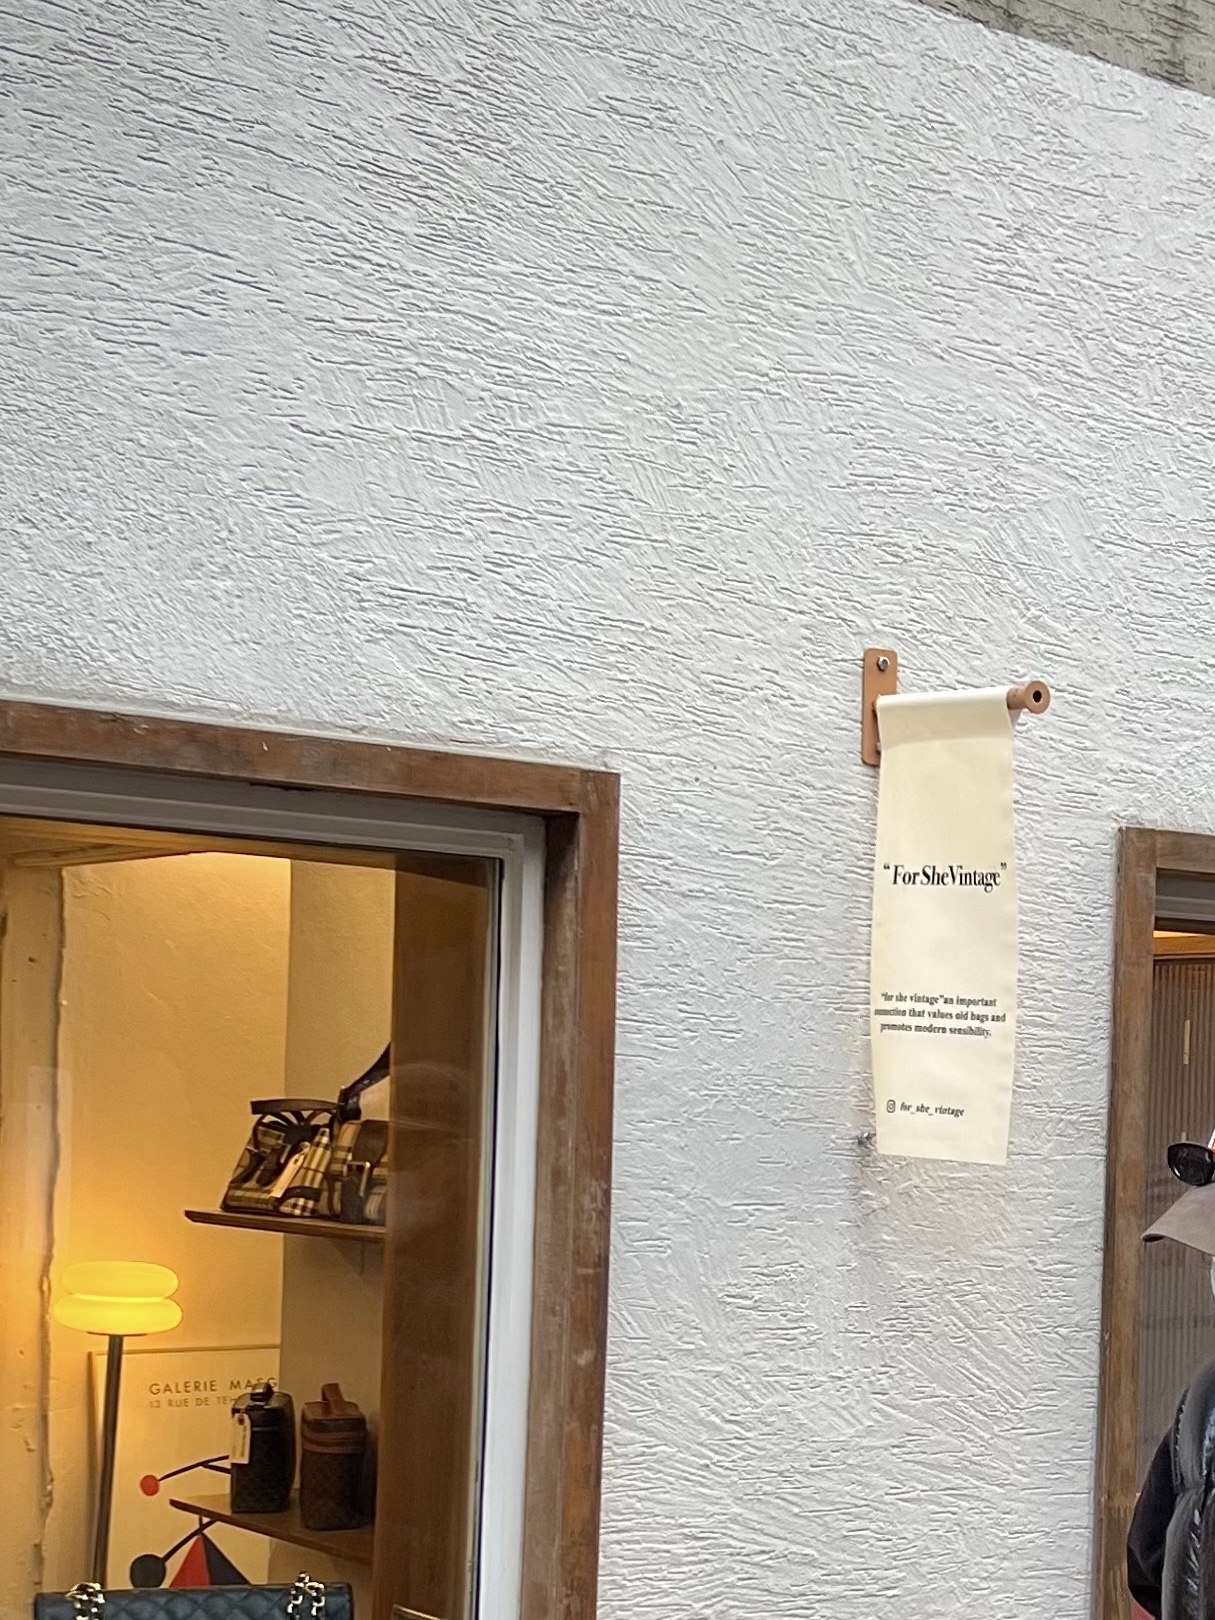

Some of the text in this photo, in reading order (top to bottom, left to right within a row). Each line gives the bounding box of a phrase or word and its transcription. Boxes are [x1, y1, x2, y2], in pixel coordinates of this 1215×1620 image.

[956, 995, 997, 1008] important
[908, 1008, 925, 1018] that
[927, 1008, 953, 1020] values
[955, 1011, 968, 1021] old
[970, 1011, 989, 1024] bags
[990, 1013, 1006, 1022] and
[914, 1023, 947, 1034] modern
[149, 1380, 217, 1396] GALERIE
[168, 1398, 189, 1408] RUE
[195, 1397, 209, 1407] DE
